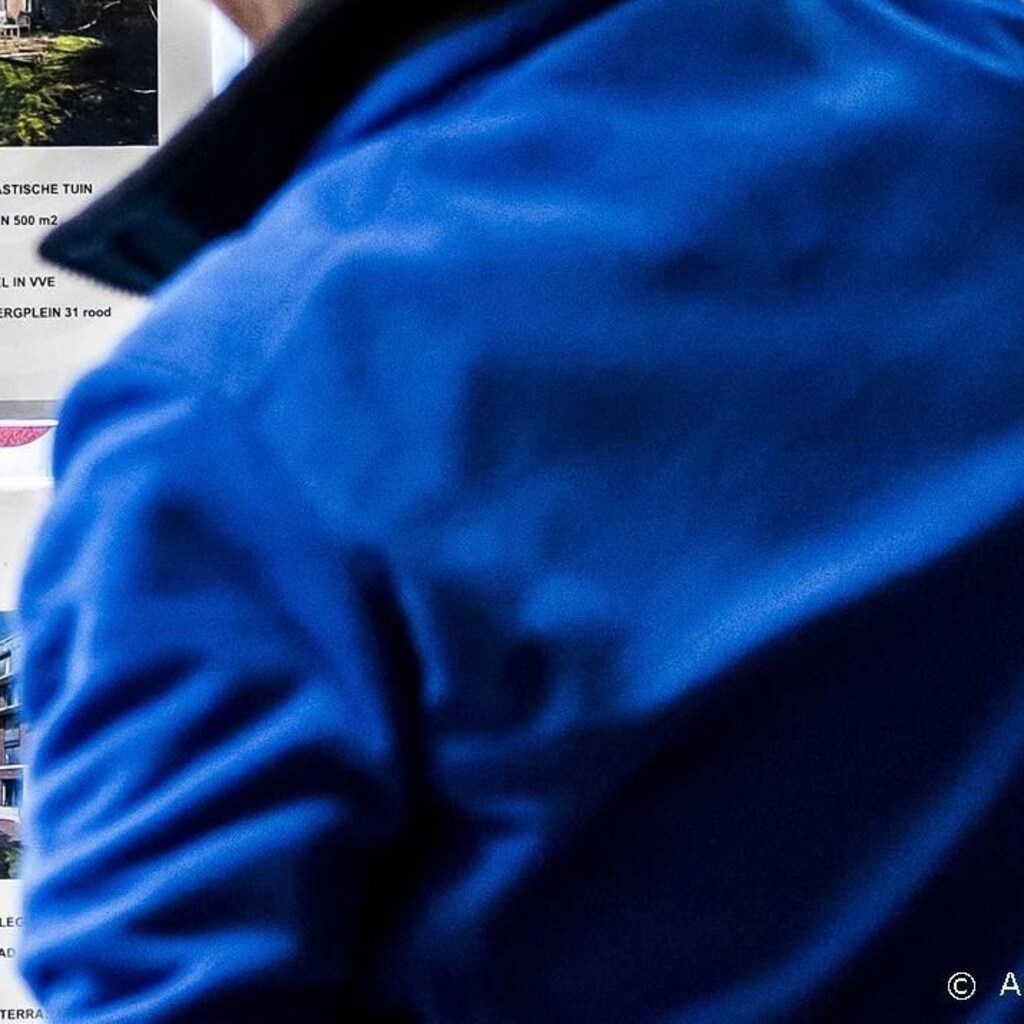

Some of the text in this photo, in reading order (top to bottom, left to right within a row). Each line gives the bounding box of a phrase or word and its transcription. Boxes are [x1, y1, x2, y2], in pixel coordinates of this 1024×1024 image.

[62, 183, 93, 196] TUIN
[64, 306, 79, 318] 31
[82, 306, 112, 318] rood
